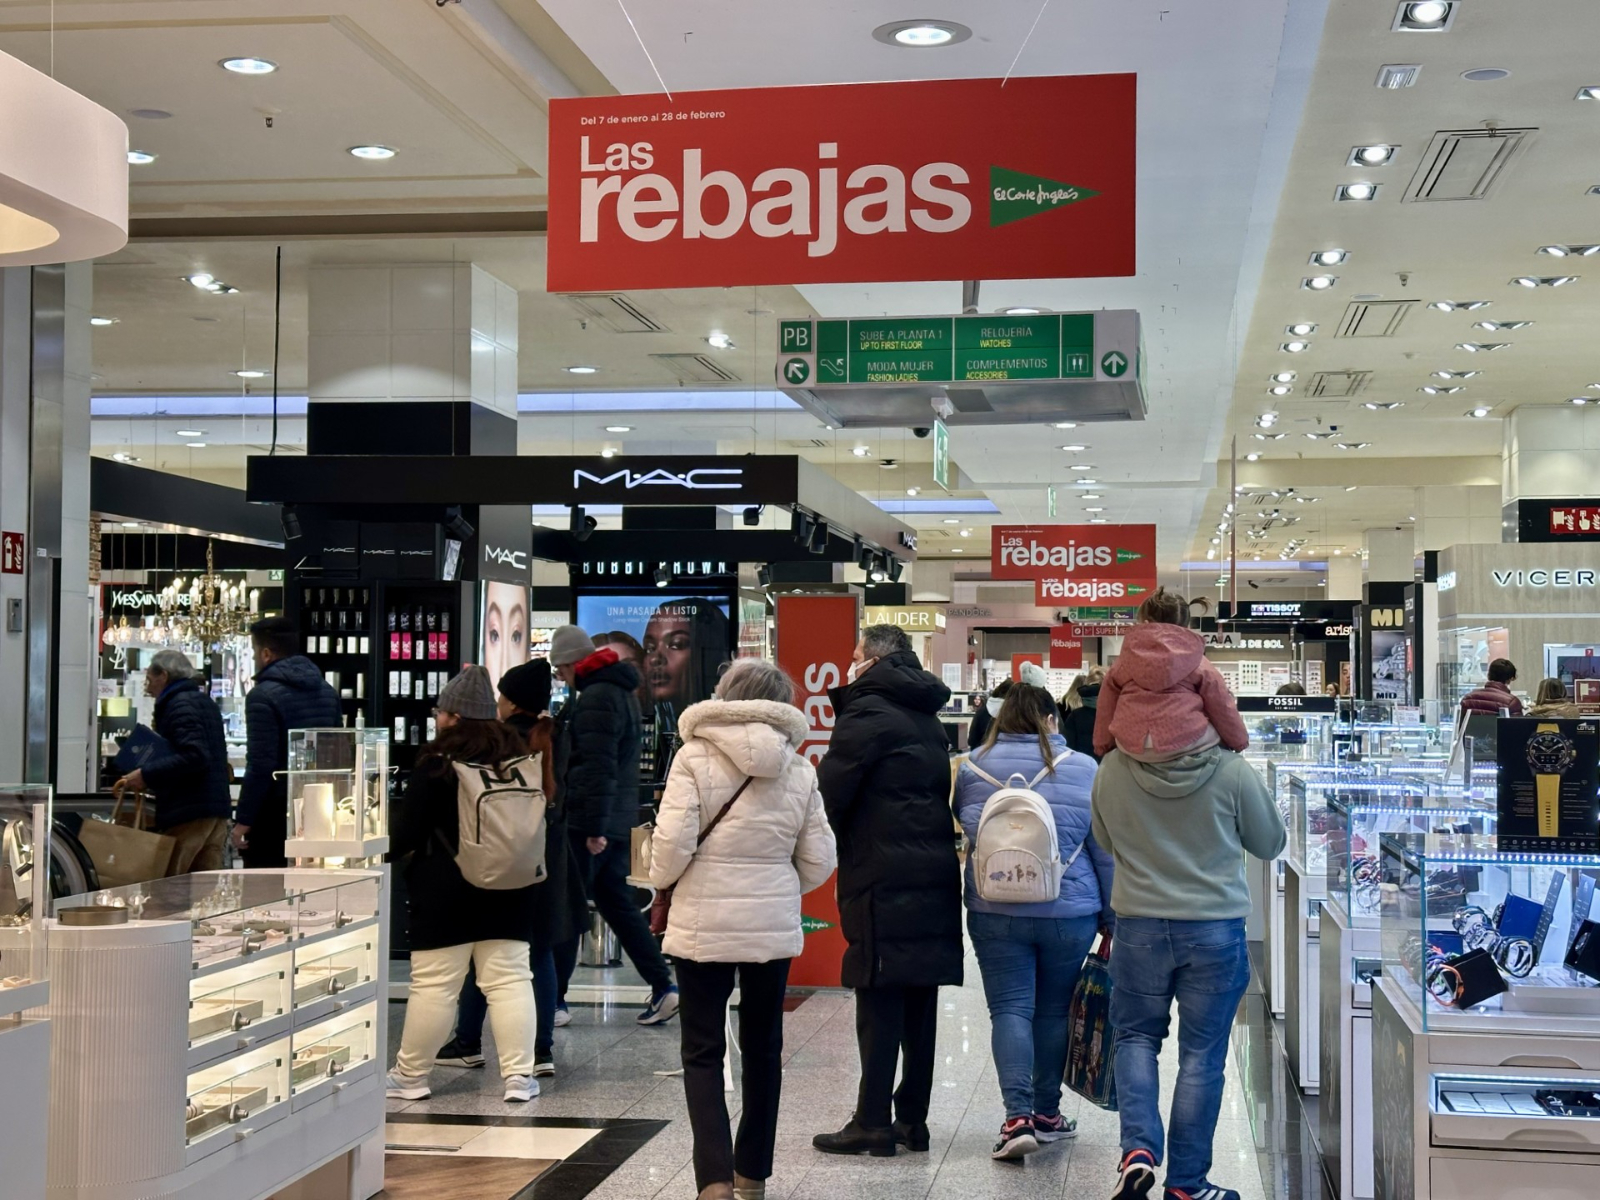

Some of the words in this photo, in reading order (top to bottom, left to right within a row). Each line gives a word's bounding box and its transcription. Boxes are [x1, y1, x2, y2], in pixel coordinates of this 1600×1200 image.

[581, 117, 596, 125] Del
[599, 116, 605, 125] 7
[607, 116, 618, 124] de
[651, 114, 659, 122] al
[662, 112, 673, 121] 28
[676, 112, 687, 120] de
[690, 110, 726, 119] febrero
[581, 136, 654, 172] Las
[580, 142, 971, 257] rebajas
[993, 187, 1006, 201] El
[1007, 187, 1036, 201] Corte
[1036, 184, 1078, 205] Inglés
[784, 327, 808, 346] PB
[860, 330, 884, 340] SUBE
[888, 330, 895, 340] A
[898, 330, 935, 340] PLANTA
[938, 330, 942, 339] 1
[981, 325, 1032, 338] RELOJERÍA
[860, 341, 870, 350] UP
[871, 341, 880, 350] TO
[881, 341, 899, 349] FIRST
[900, 341, 922, 349] FLOOR
[980, 339, 1011, 347] WATCHES
[867, 362, 897, 372] MODA
[900, 361, 933, 371] MUJER
[966, 358, 1047, 369] COMPLEMENTOS
[867, 373, 894, 382] FASHION
[895, 373, 918, 382] LADIES
[966, 371, 1008, 379] ACCESORIES
[1001, 535, 1023, 546] Las
[1001, 540, 1112, 572] rebajas
[1042, 579, 1124, 602] rebajas
[607, 606, 624, 616] UNA
[628, 606, 661, 615] PASADA
[664, 606, 670, 615] Y
[673, 605, 697, 615] LISTO
[948, 608, 992, 617] PANDORA
[1264, 604, 1301, 612] TISSOT
[866, 611, 929, 626] LAUDER
[1051, 639, 1081, 648] rebajas
[1203, 634, 1232, 644] CAA
[1263, 639, 1285, 648] SOL
[1268, 697, 1303, 706] FOSSIL
